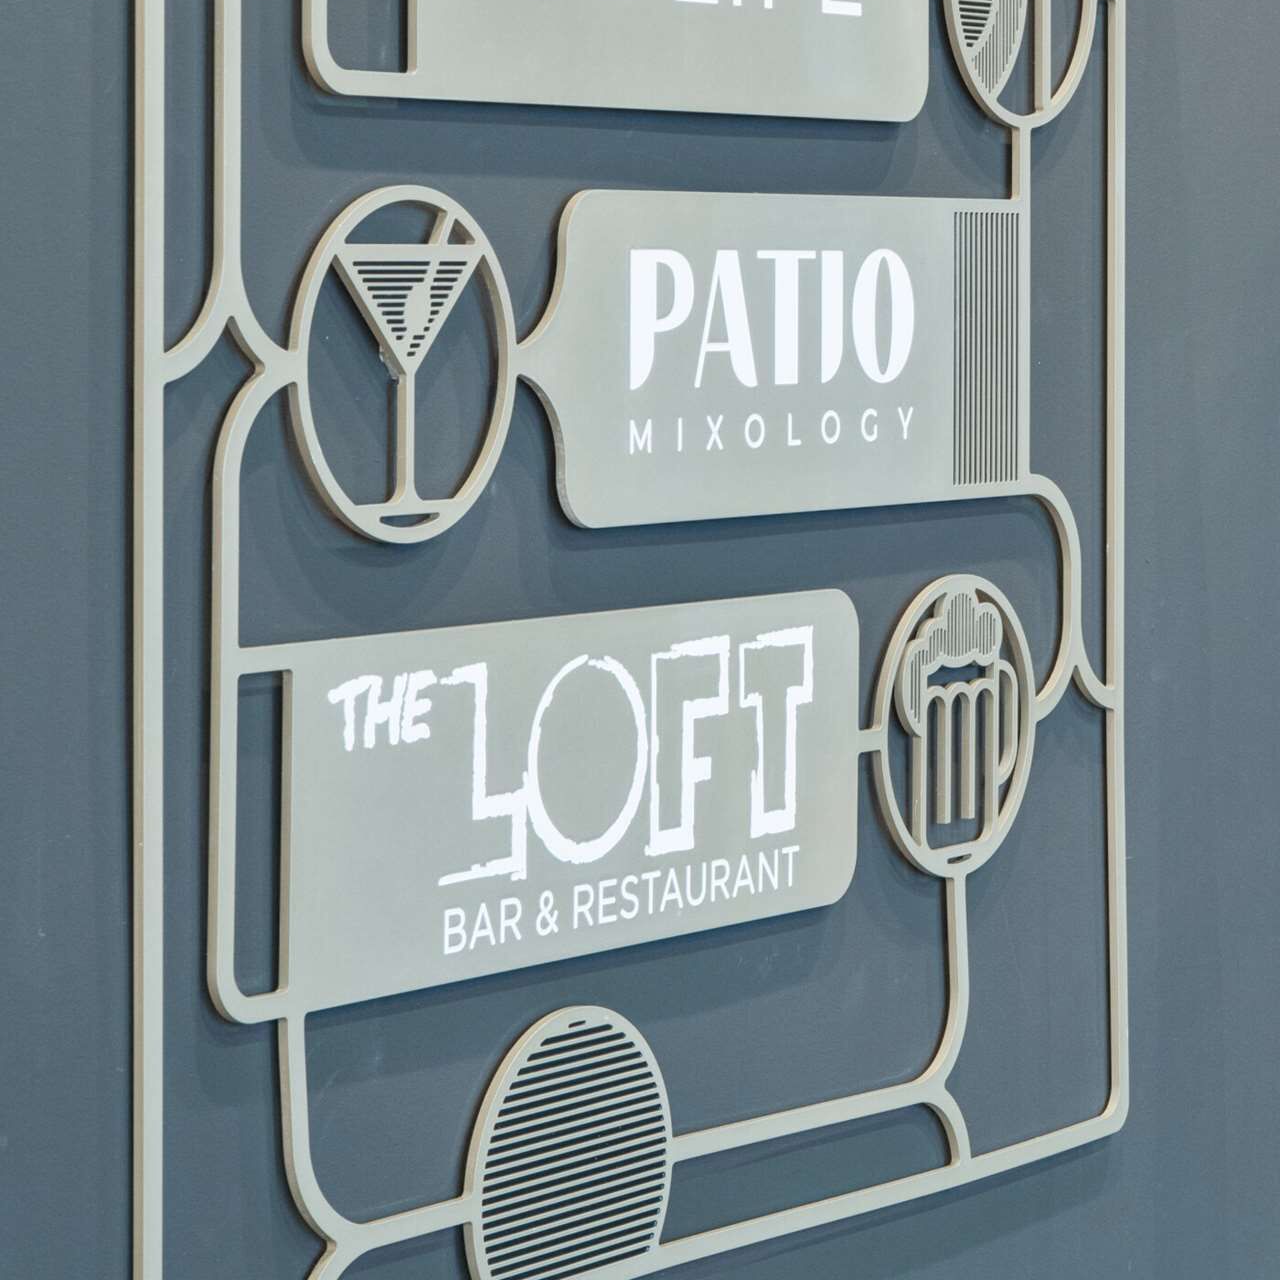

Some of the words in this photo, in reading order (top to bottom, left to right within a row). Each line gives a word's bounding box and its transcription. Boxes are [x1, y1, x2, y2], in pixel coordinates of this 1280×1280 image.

[629, 247, 915, 390] PATIO
[628, 406, 915, 455] MIXOLOGY
[327, 669, 440, 752] THE
[438, 625, 814, 887] LOFT
[442, 901, 524, 955] BAR
[535, 892, 560, 937] &
[572, 844, 801, 929] RESTAURANT
